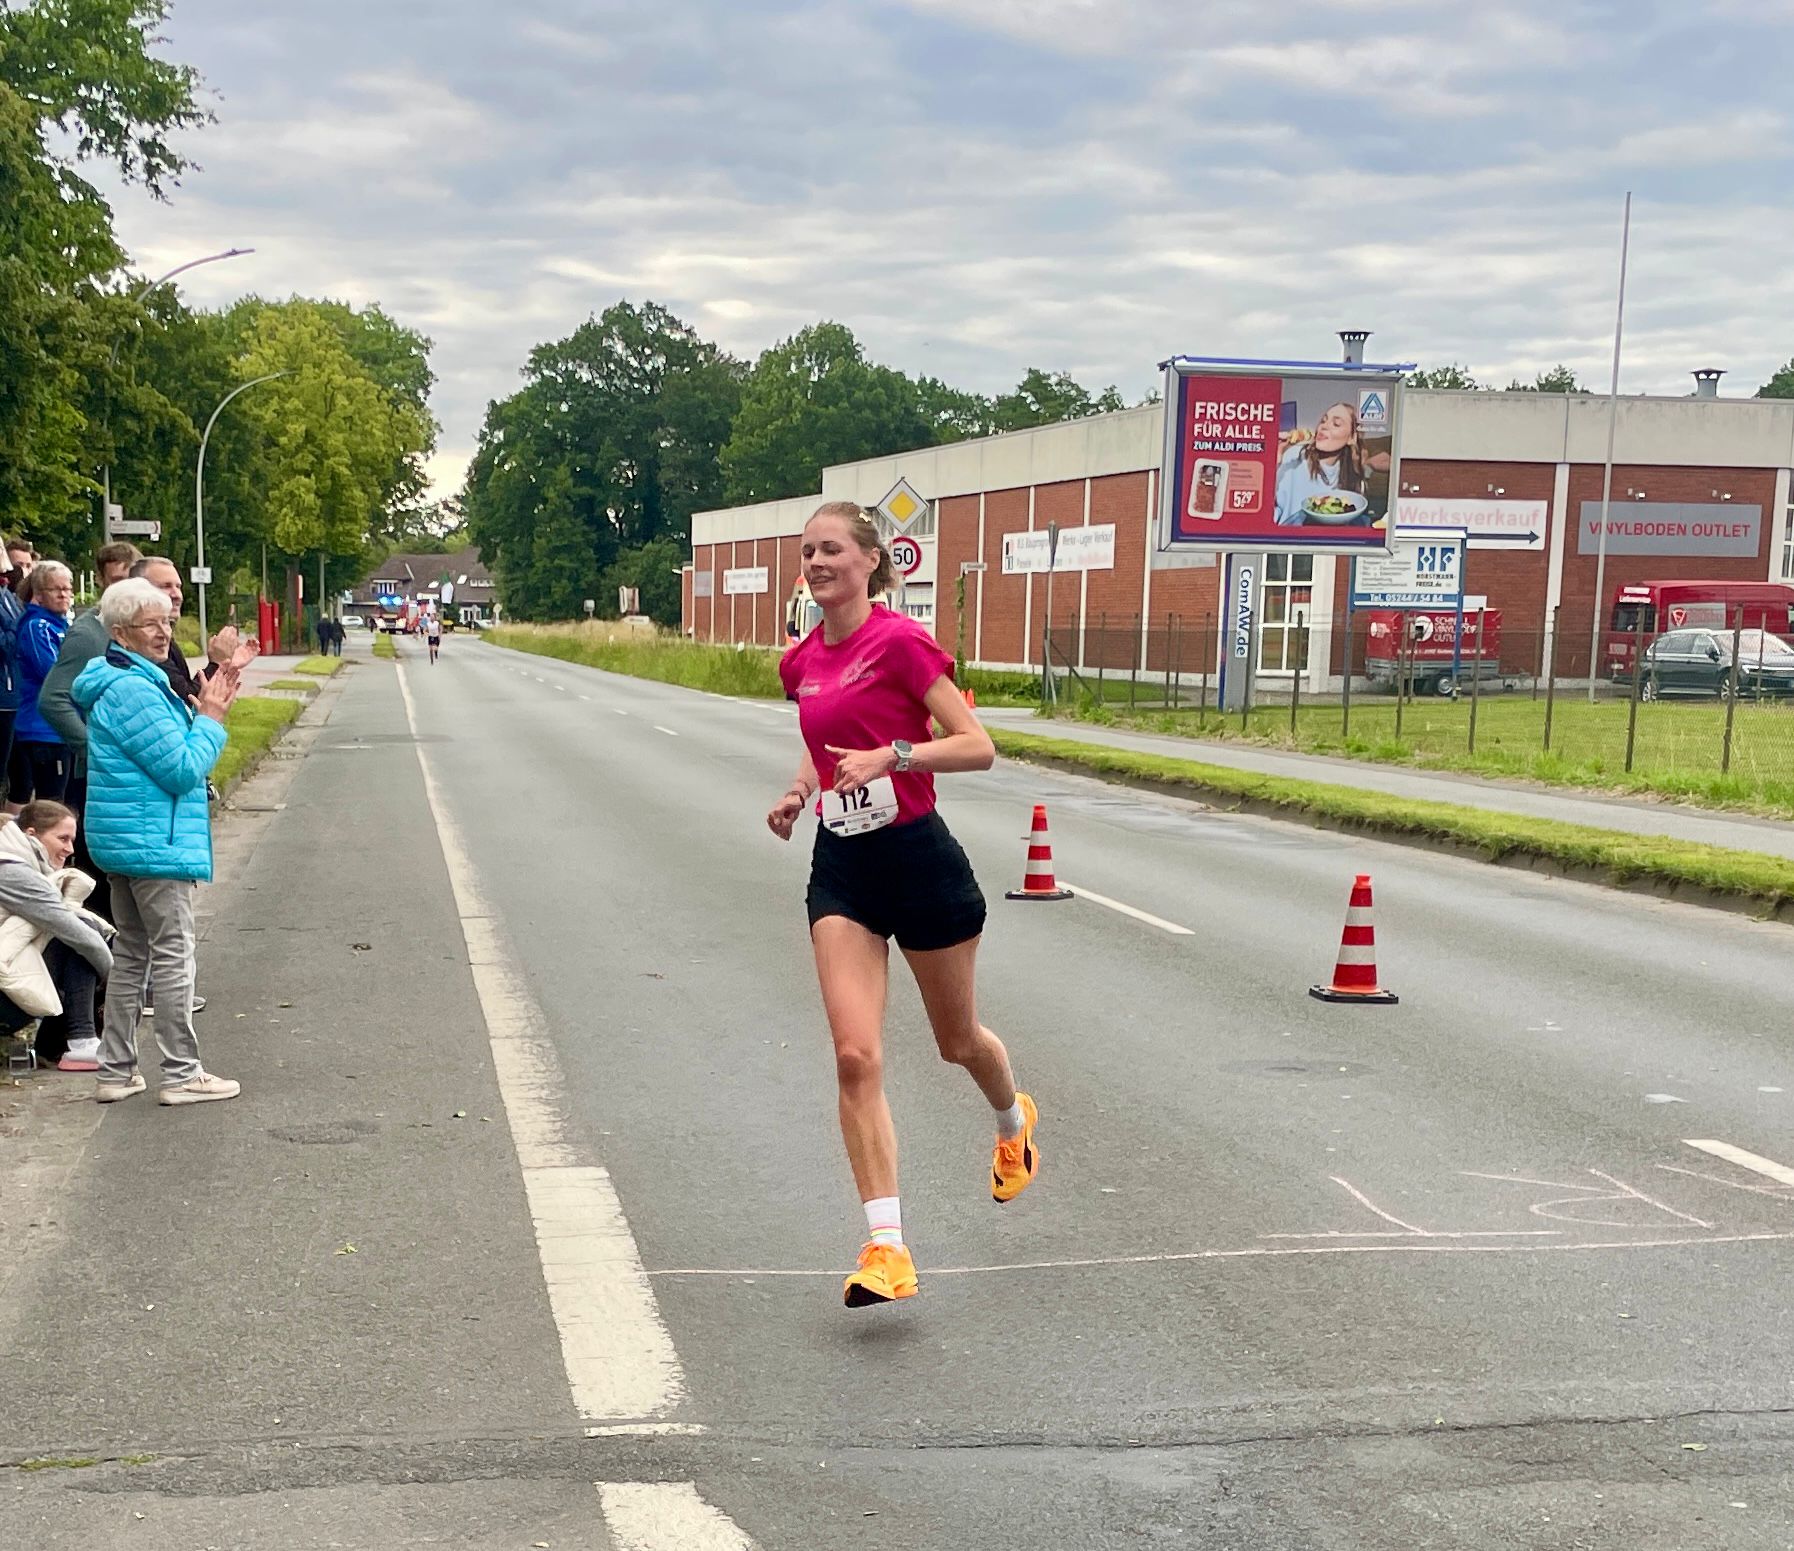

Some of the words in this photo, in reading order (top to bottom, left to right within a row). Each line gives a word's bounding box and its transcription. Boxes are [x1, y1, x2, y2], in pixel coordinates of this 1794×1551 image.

[1194, 401, 1275, 422] FRISCHE
[1193, 420, 1222, 438] FÜR
[1224, 424, 1265, 440] ALLE.
[1192, 440, 1213, 451] ZUM
[1213, 441, 1235, 452] ALDI
[1398, 506, 1541, 528] Werksverkauf
[1691, 523, 1751, 538] OUTLET
[893, 547, 914, 566] 50
[839, 786, 873, 813] 112
